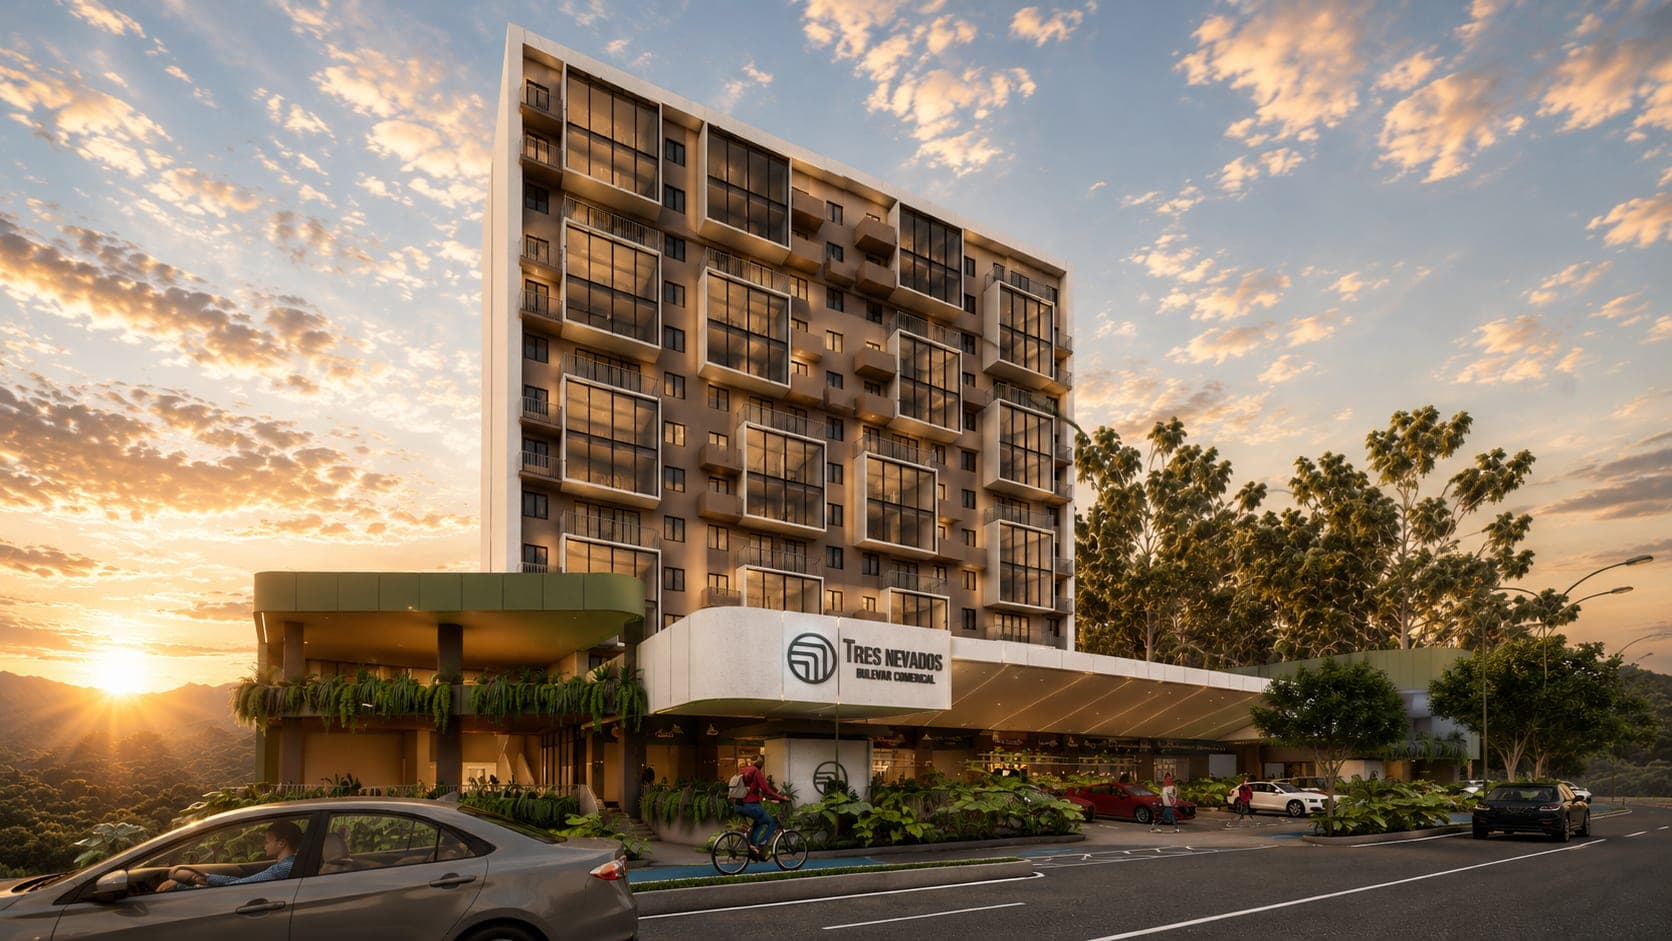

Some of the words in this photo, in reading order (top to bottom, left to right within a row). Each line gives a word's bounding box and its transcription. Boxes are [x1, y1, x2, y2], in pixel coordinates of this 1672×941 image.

[842, 638, 882, 665] TRES
[885, 648, 943, 671] NEVADOS
[856, 668, 892, 681] BULEVAR
